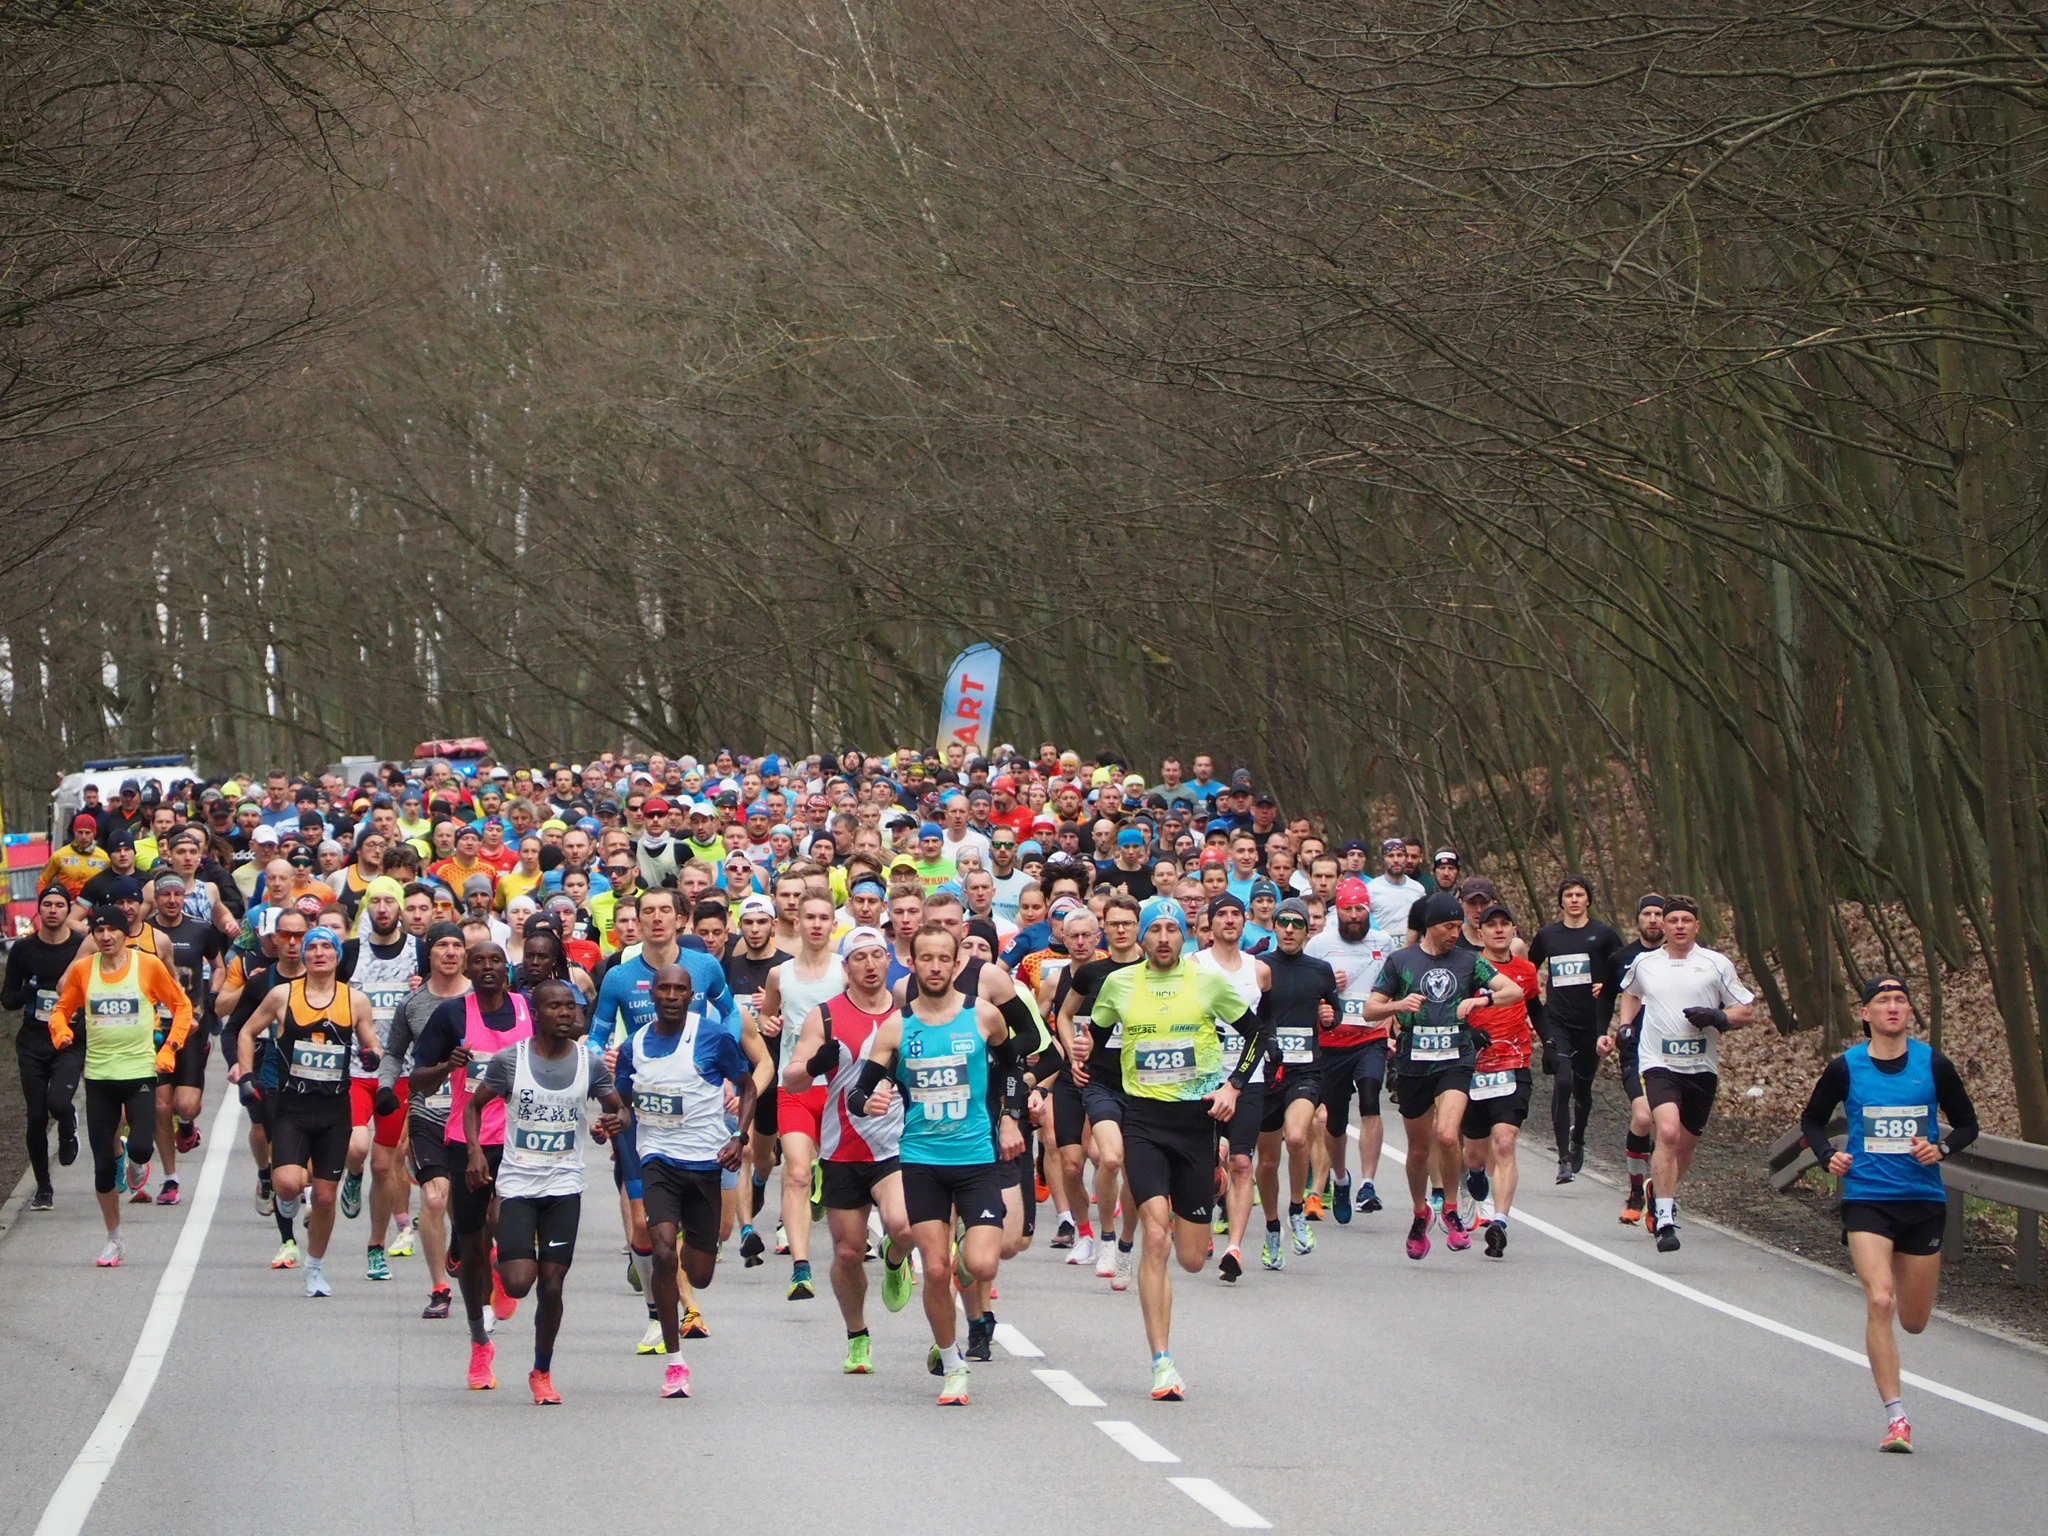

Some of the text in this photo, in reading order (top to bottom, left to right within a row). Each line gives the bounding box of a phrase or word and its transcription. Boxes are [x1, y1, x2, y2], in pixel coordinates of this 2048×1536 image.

[1556, 962, 1583, 976] 107
[97, 1000, 131, 1015] 489
[1419, 1035, 1452, 1050] 018
[1669, 1041, 1701, 1056] 045
[300, 1051, 337, 1069] 014
[1143, 1051, 1186, 1070] 428
[916, 1068, 959, 1088] 548
[1475, 1071, 1509, 1088] 678
[638, 1094, 674, 1115] 255
[1873, 1119, 1918, 1138] 589
[525, 1132, 567, 1152] 074
